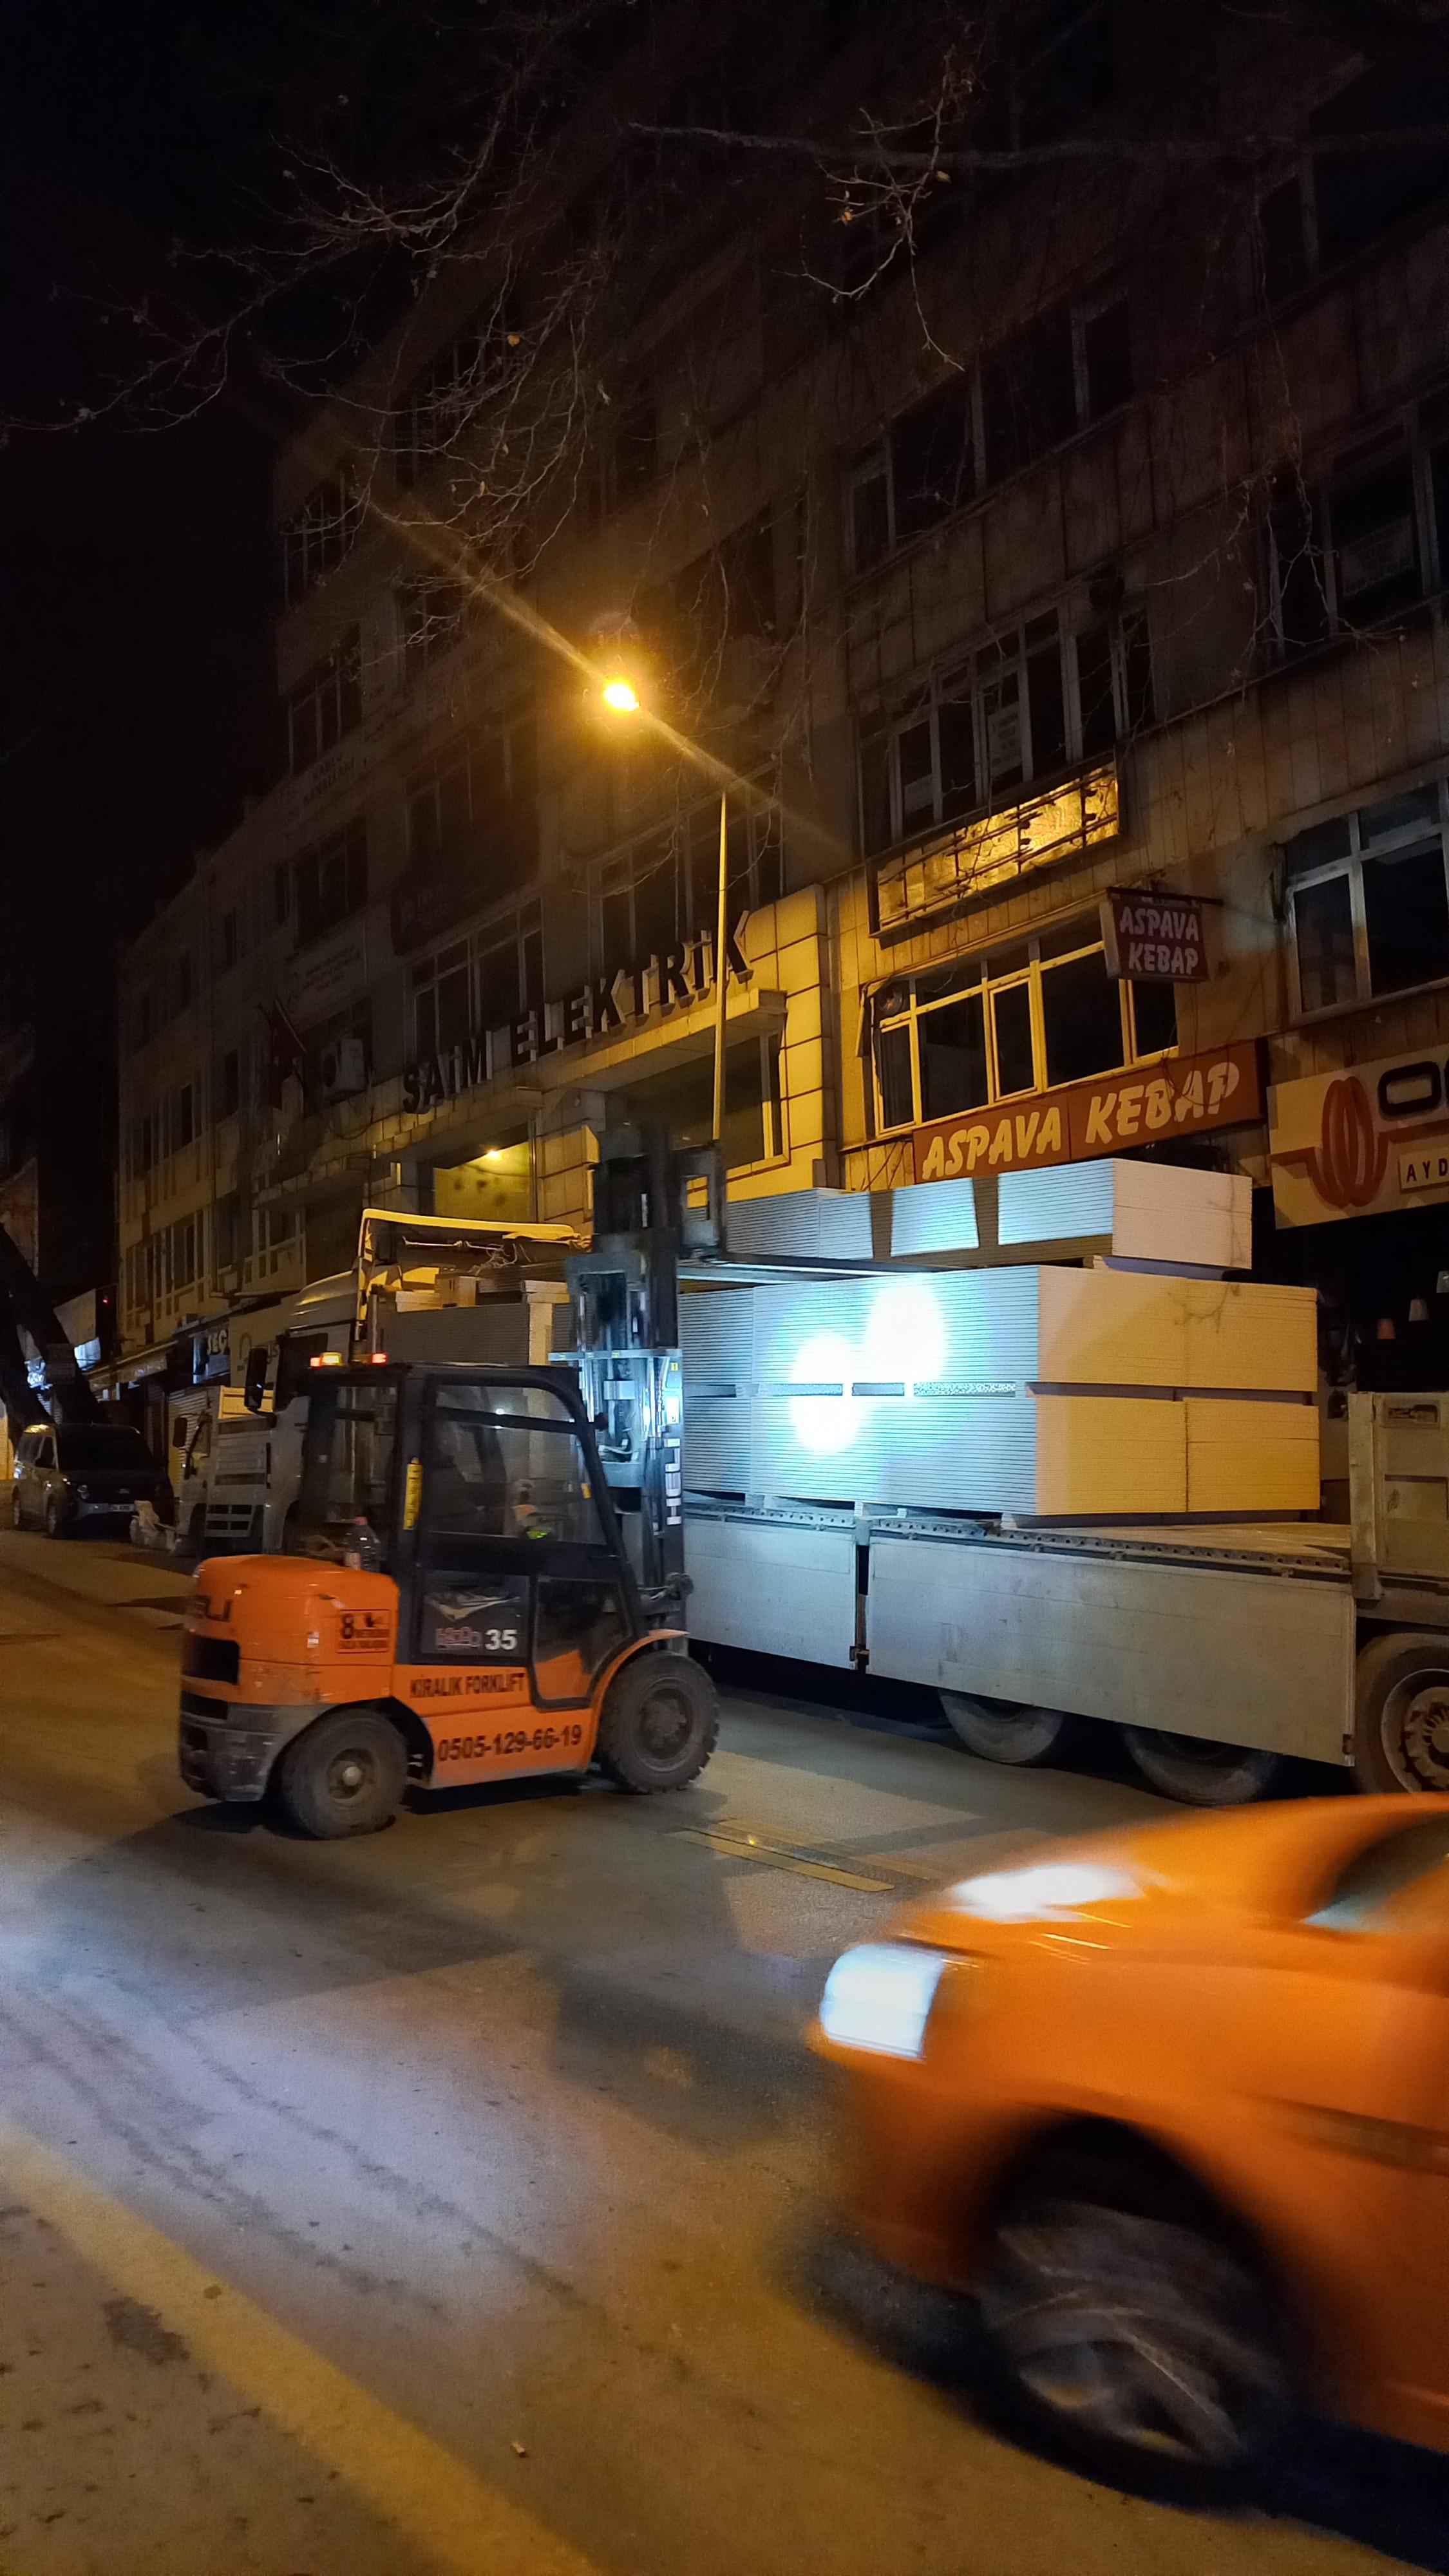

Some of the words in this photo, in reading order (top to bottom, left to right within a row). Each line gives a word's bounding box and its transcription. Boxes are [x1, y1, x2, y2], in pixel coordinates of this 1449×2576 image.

[1119, 905, 1199, 942] ASPAVA
[1128, 942, 1198, 975] KEBAP
[922, 1106, 1062, 1180] ASPAVA
[1084, 1061, 1240, 1145] KEBAP
[485, 1629, 518, 1650] 35
[438, 1724, 582, 1761] 0505-129-66-19
